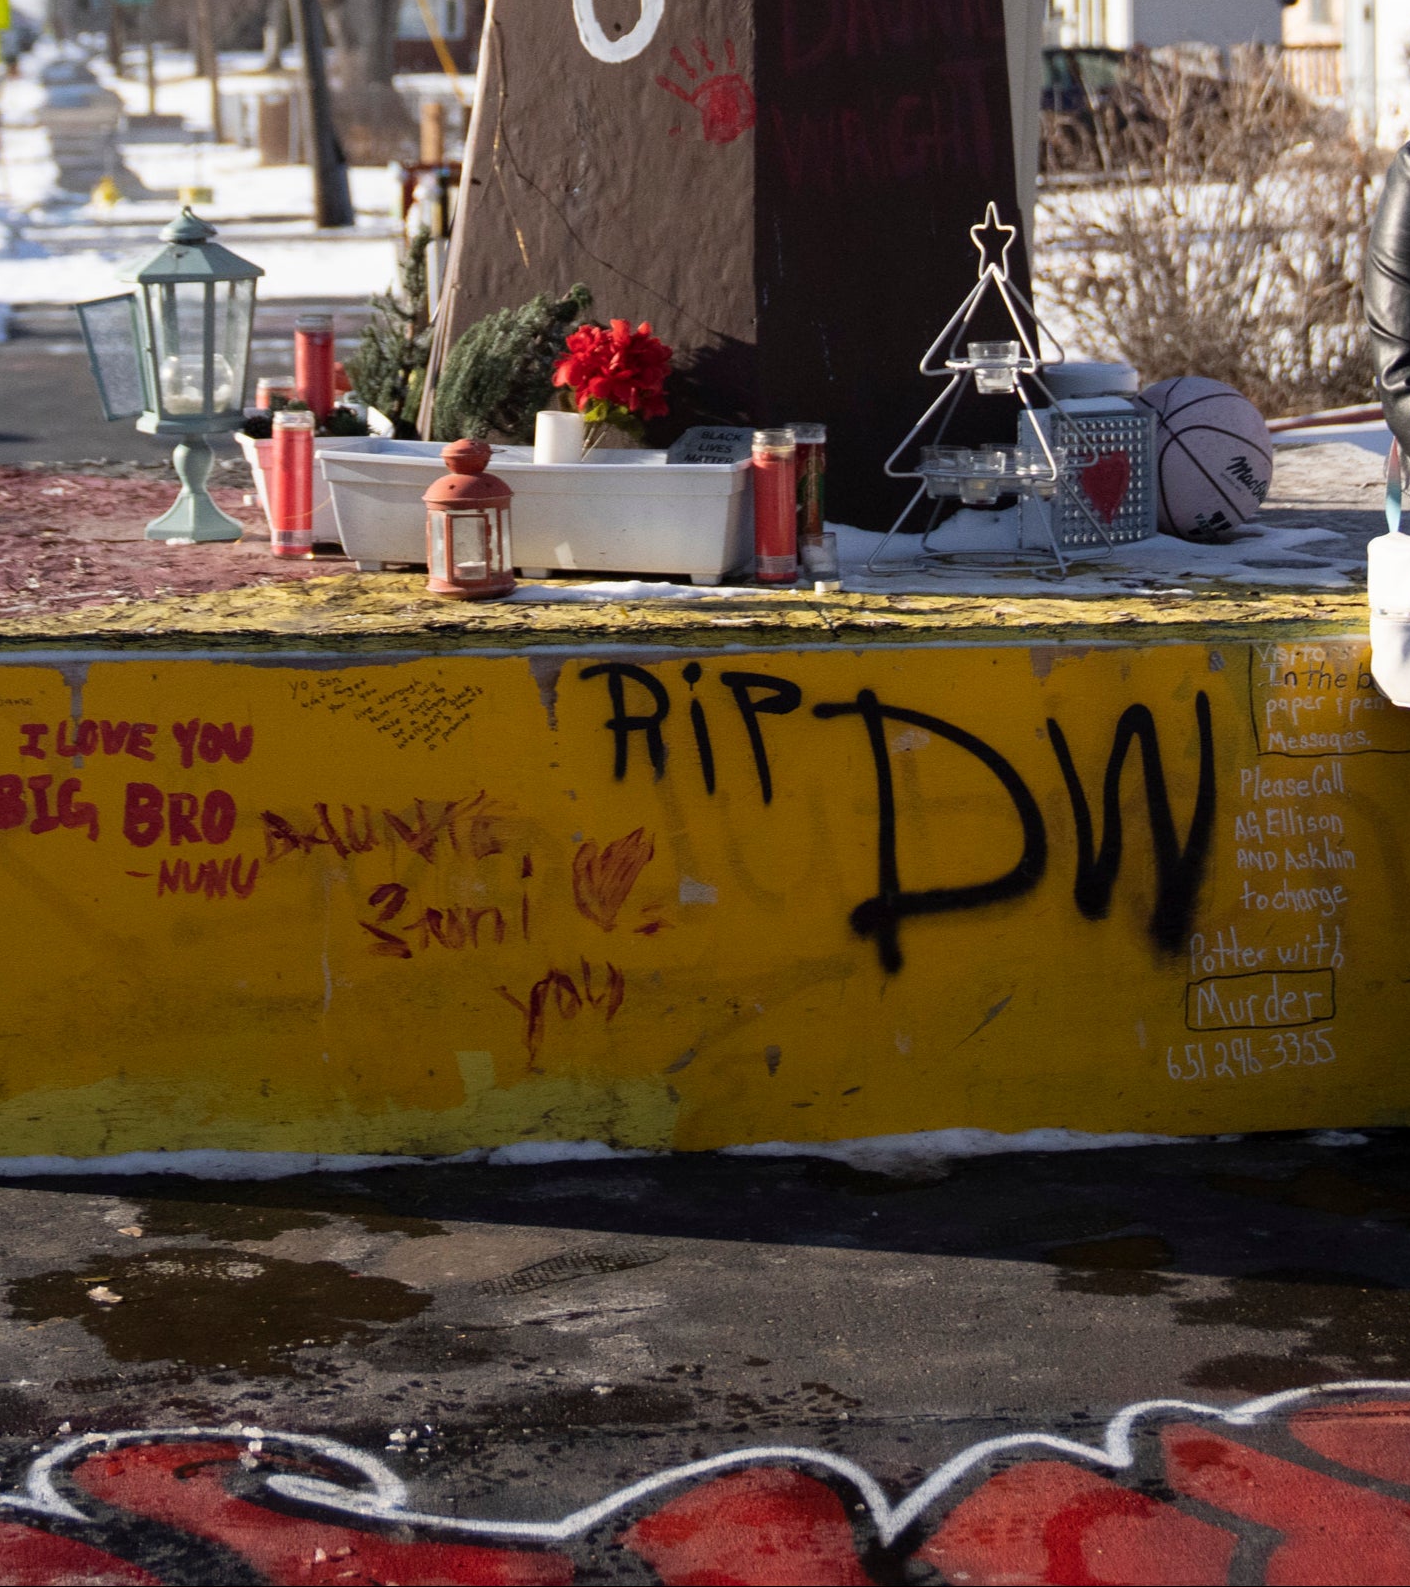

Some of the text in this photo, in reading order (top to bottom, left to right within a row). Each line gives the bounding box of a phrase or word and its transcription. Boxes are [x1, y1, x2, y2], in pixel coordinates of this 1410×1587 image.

[697, 443, 732, 454] LIVES
[700, 430, 743, 442] BLACK
[1300, 661, 1348, 690] the
[1265, 695, 1326, 728] paper
[20, 718, 254, 768] I LOVE YOU
[122, 782, 237, 848] BRO
[1190, 926, 1266, 975] Potter
[1197, 975, 1323, 1027] Murder
